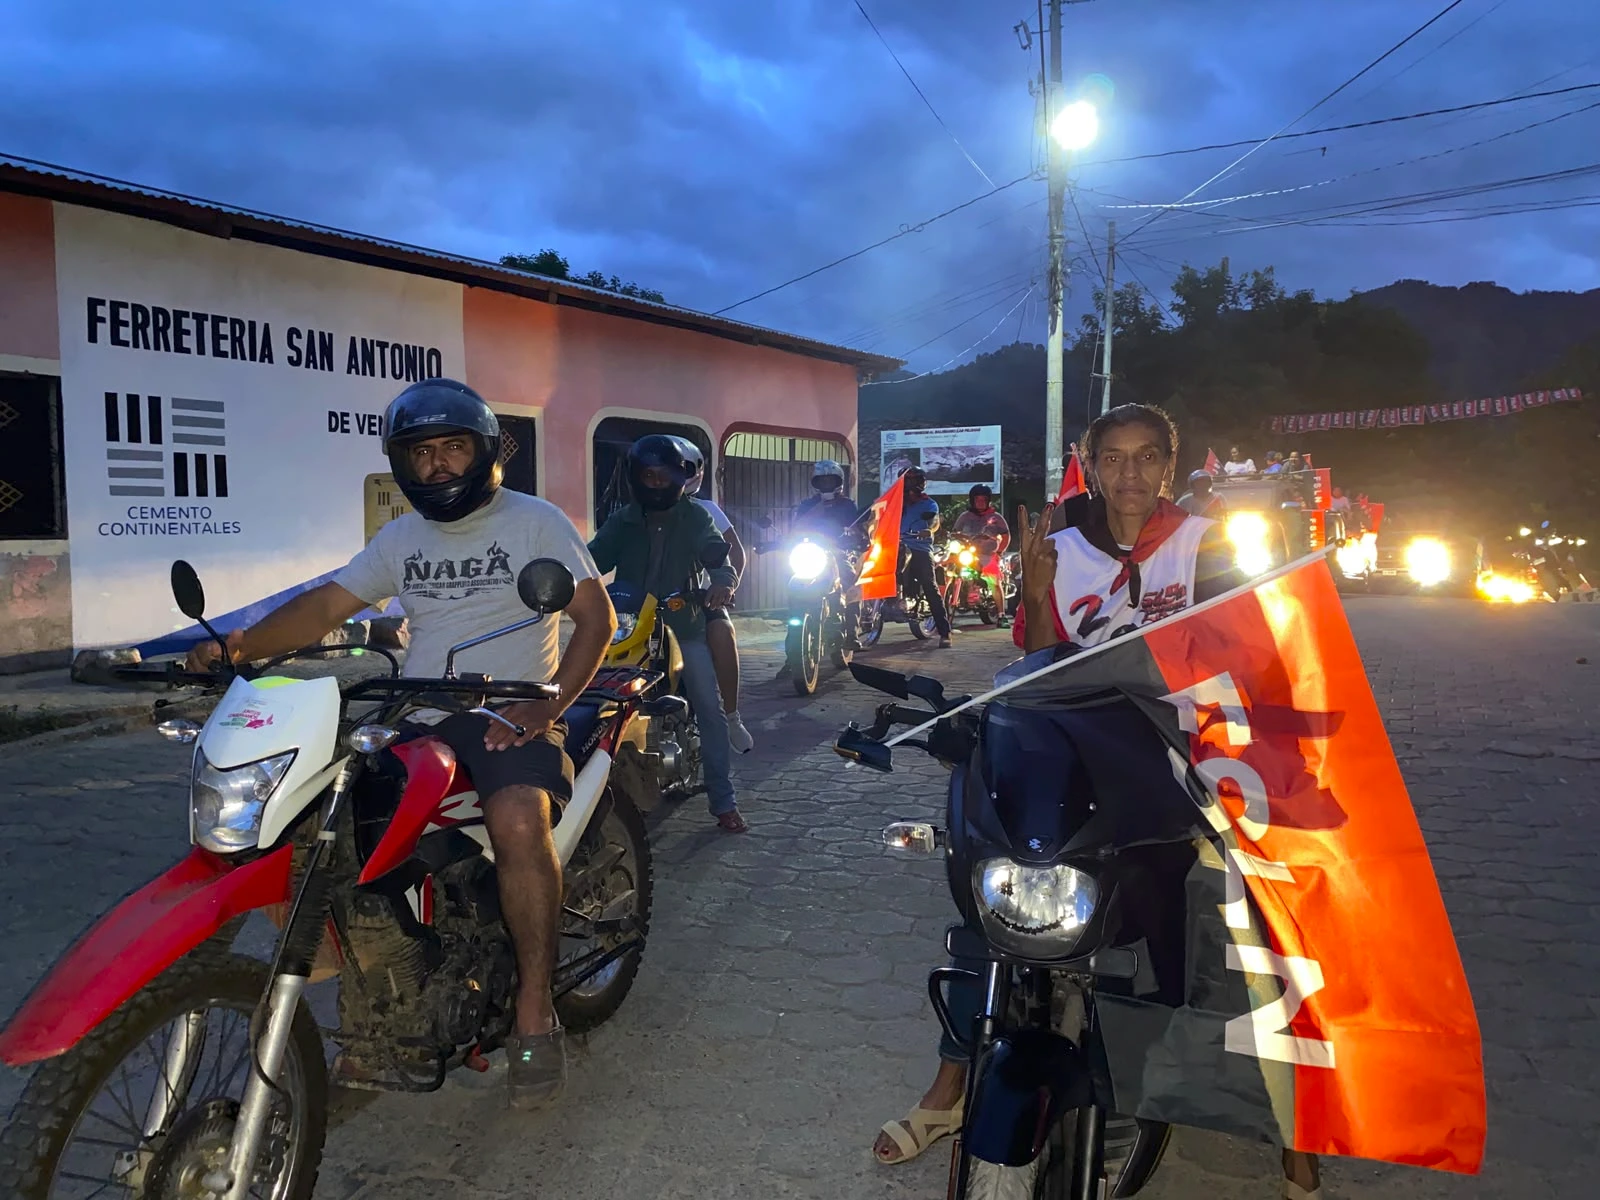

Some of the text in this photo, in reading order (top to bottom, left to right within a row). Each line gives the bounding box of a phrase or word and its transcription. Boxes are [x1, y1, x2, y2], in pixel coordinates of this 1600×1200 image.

[87, 297, 442, 383] FERRETERIA SAN ANTONIO
[328, 410, 350, 434] DE
[1313, 476, 1323, 503] FSLN
[127, 506, 212, 520] CEMENTO
[98, 521, 242, 536] CONTINENTALES
[1309, 518, 1318, 547] FSLN
[402, 547, 513, 582] NAGA
